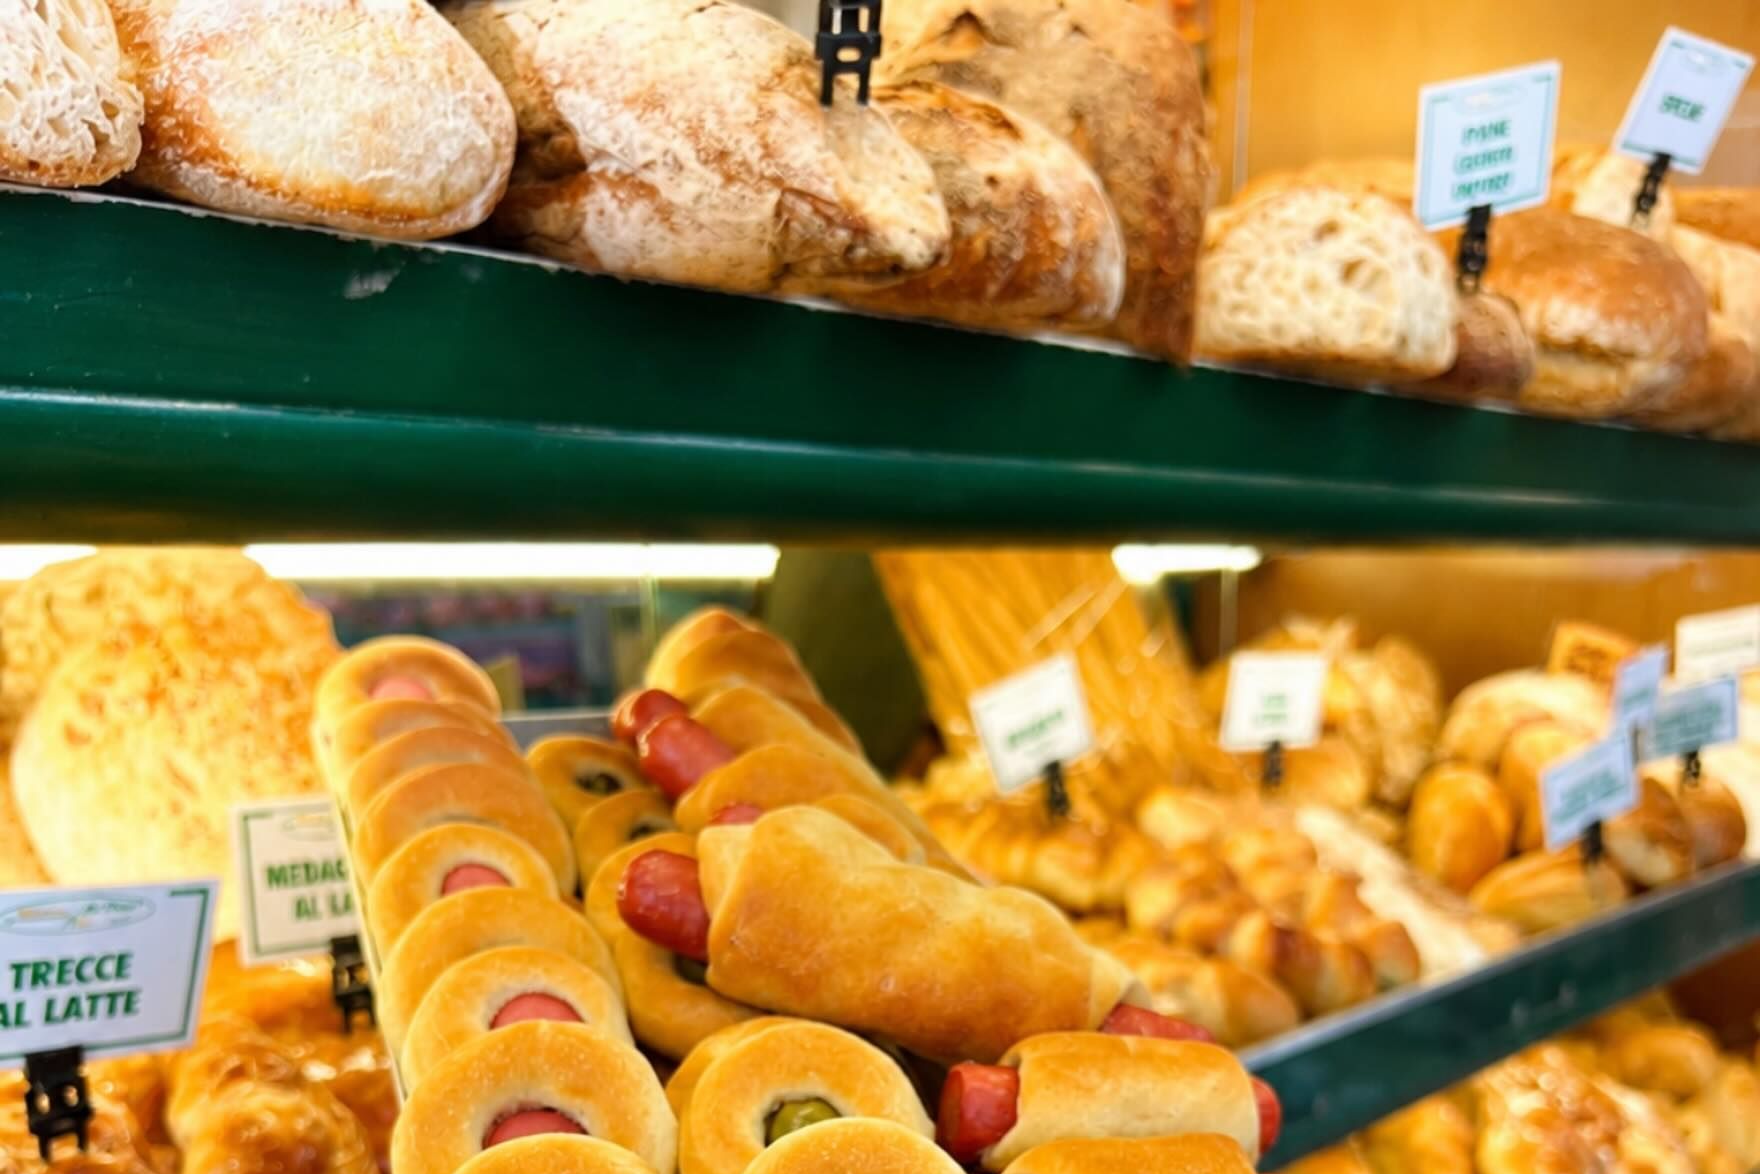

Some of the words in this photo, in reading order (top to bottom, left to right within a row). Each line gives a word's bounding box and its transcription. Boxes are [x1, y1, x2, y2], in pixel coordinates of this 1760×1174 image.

[294, 893, 323, 921] AL
[9, 952, 133, 992] TRECCE
[0, 1001, 32, 1030] AL
[44, 990, 141, 1026] LATTE
